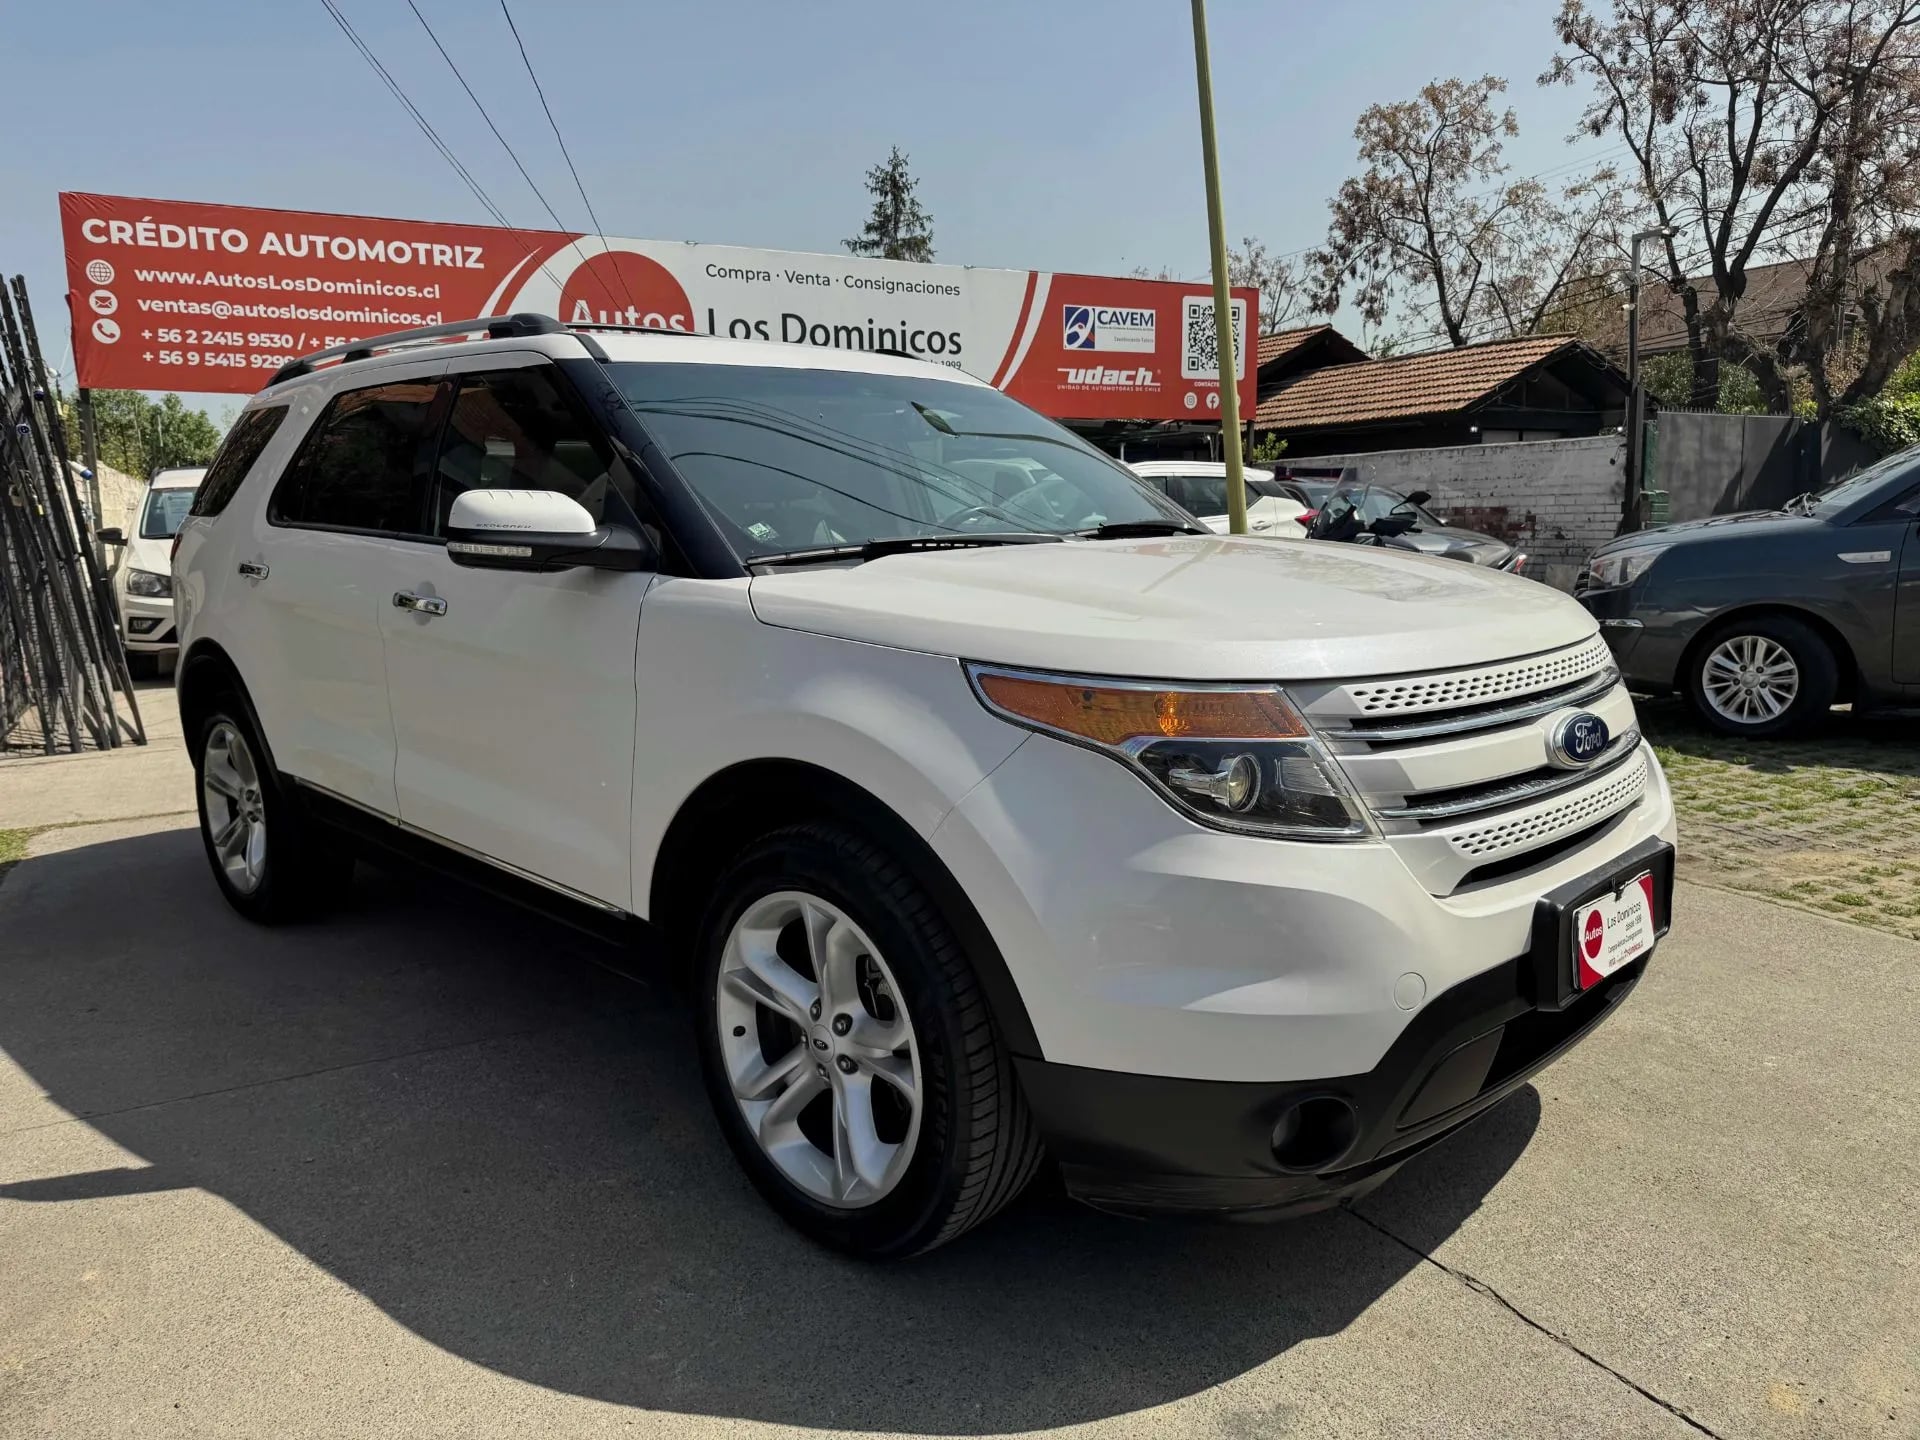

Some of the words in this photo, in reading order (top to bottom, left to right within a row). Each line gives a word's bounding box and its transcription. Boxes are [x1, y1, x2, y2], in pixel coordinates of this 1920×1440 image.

[81, 216, 249, 254] CRÉDITO
[259, 232, 485, 269] AUTOMOTRIZ
[134, 269, 440, 299] www.AutosLosDominicos.cl
[705, 263, 771, 283] Compra
[784, 269, 830, 286] Venta
[843, 275, 961, 296] Consignaciones
[136, 299, 442, 326] ventas@autoslosdominicos.cl
[572, 299, 686, 333] Autos
[1097, 310, 1154, 327] CAVEM
[157, 328, 182, 343] 56
[185, 329, 198, 344] 2
[201, 330, 244, 346] 2415
[247, 333, 294, 349] 9530
[707, 307, 770, 341] Los
[781, 312, 962, 355] Dominicos
[158, 350, 184, 365] 56
[186, 351, 200, 366] 9
[204, 352, 247, 368] 5415
[1574, 720, 1603, 754] Ford
[1584, 925, 1603, 943] Autos
[1607, 917, 1617, 930] Los
